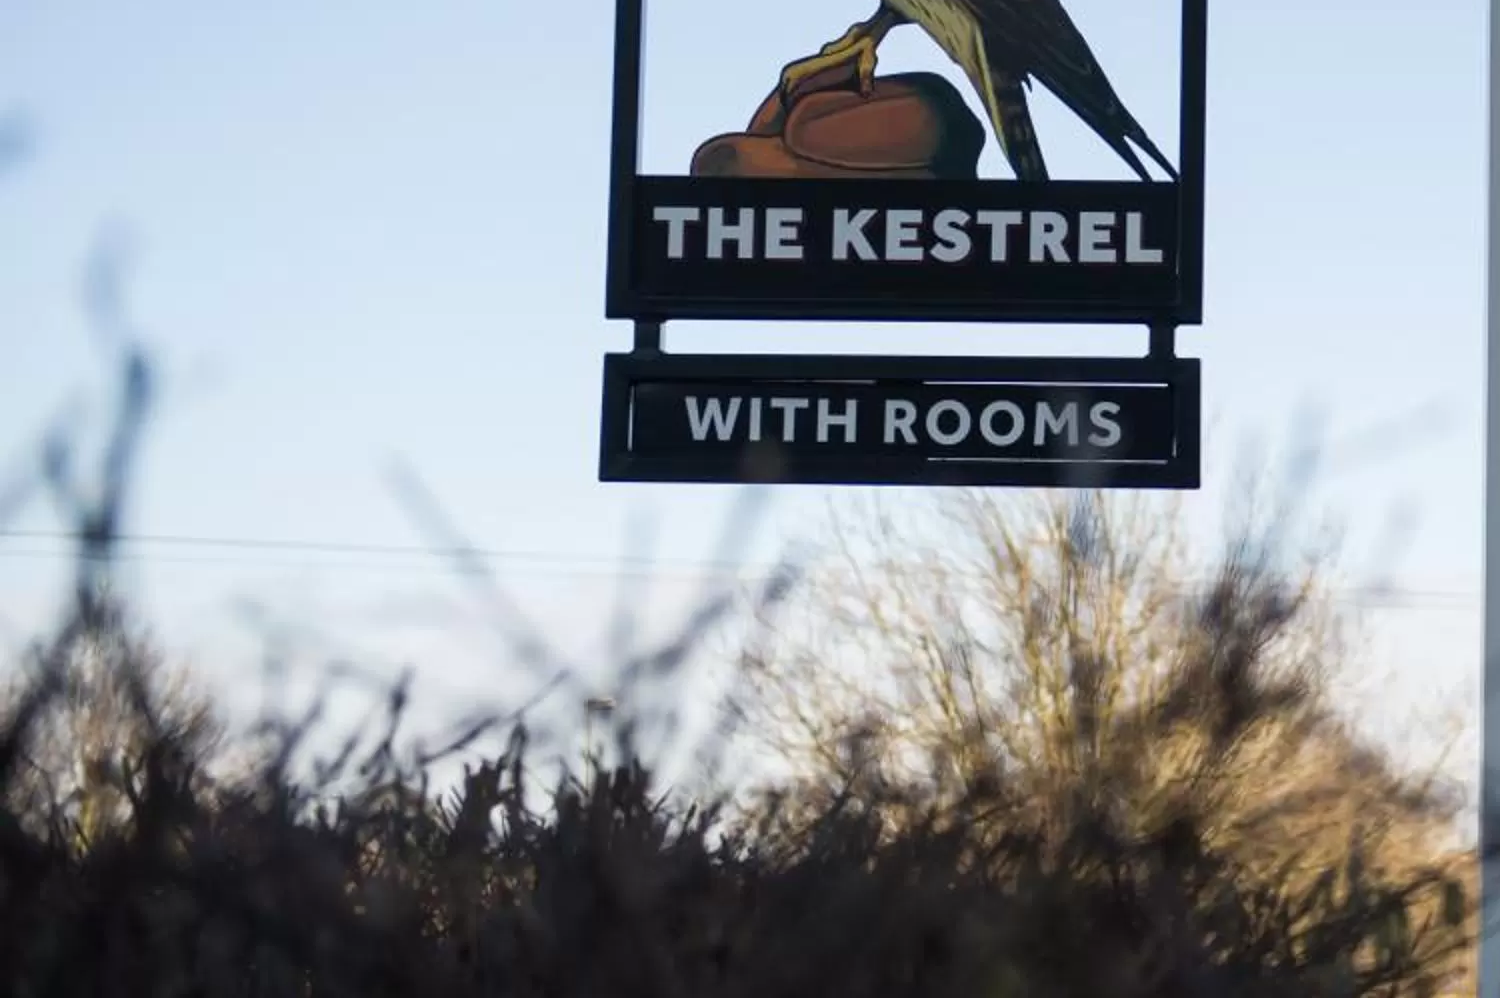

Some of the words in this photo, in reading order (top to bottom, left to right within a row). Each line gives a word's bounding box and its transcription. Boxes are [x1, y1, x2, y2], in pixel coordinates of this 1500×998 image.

[653, 206, 804, 260] THE
[832, 208, 1164, 264] KESTREL
[685, 396, 858, 444] WITH
[882, 399, 1122, 448] ROOMS
